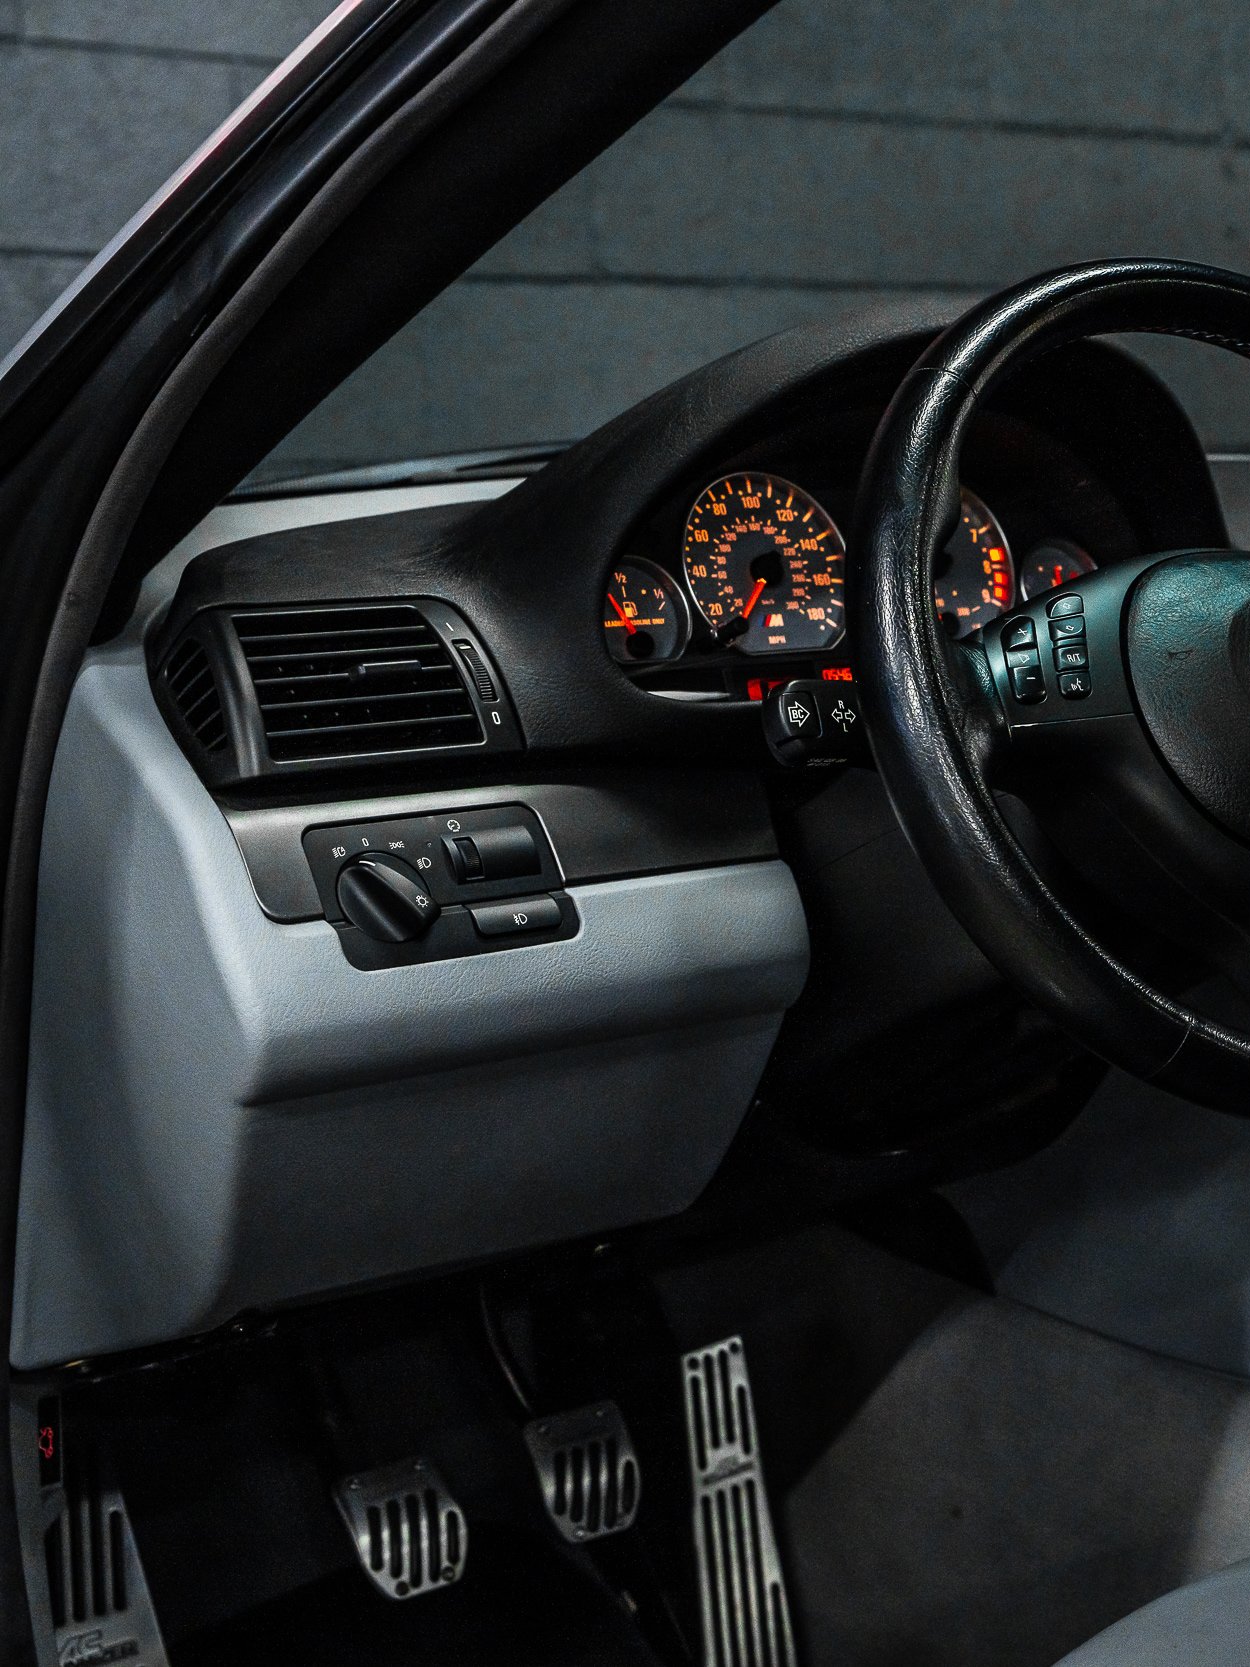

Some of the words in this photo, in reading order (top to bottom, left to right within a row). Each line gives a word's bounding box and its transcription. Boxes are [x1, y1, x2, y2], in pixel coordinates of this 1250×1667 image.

[741, 496, 760, 508] 100
[713, 503, 727, 515] 80
[776, 509, 794, 522] 120
[694, 529, 709, 542] 60
[800, 538, 818, 551] 140
[692, 564, 707, 577] 40
[812, 573, 831, 586] 160
[708, 603, 723, 616] 20
[806, 607, 825, 620] 180
[1066, 653, 1082, 663] R/T
[838, 700, 845, 710] R
[791, 709, 805, 720] BC
[842, 722, 849, 733] L
